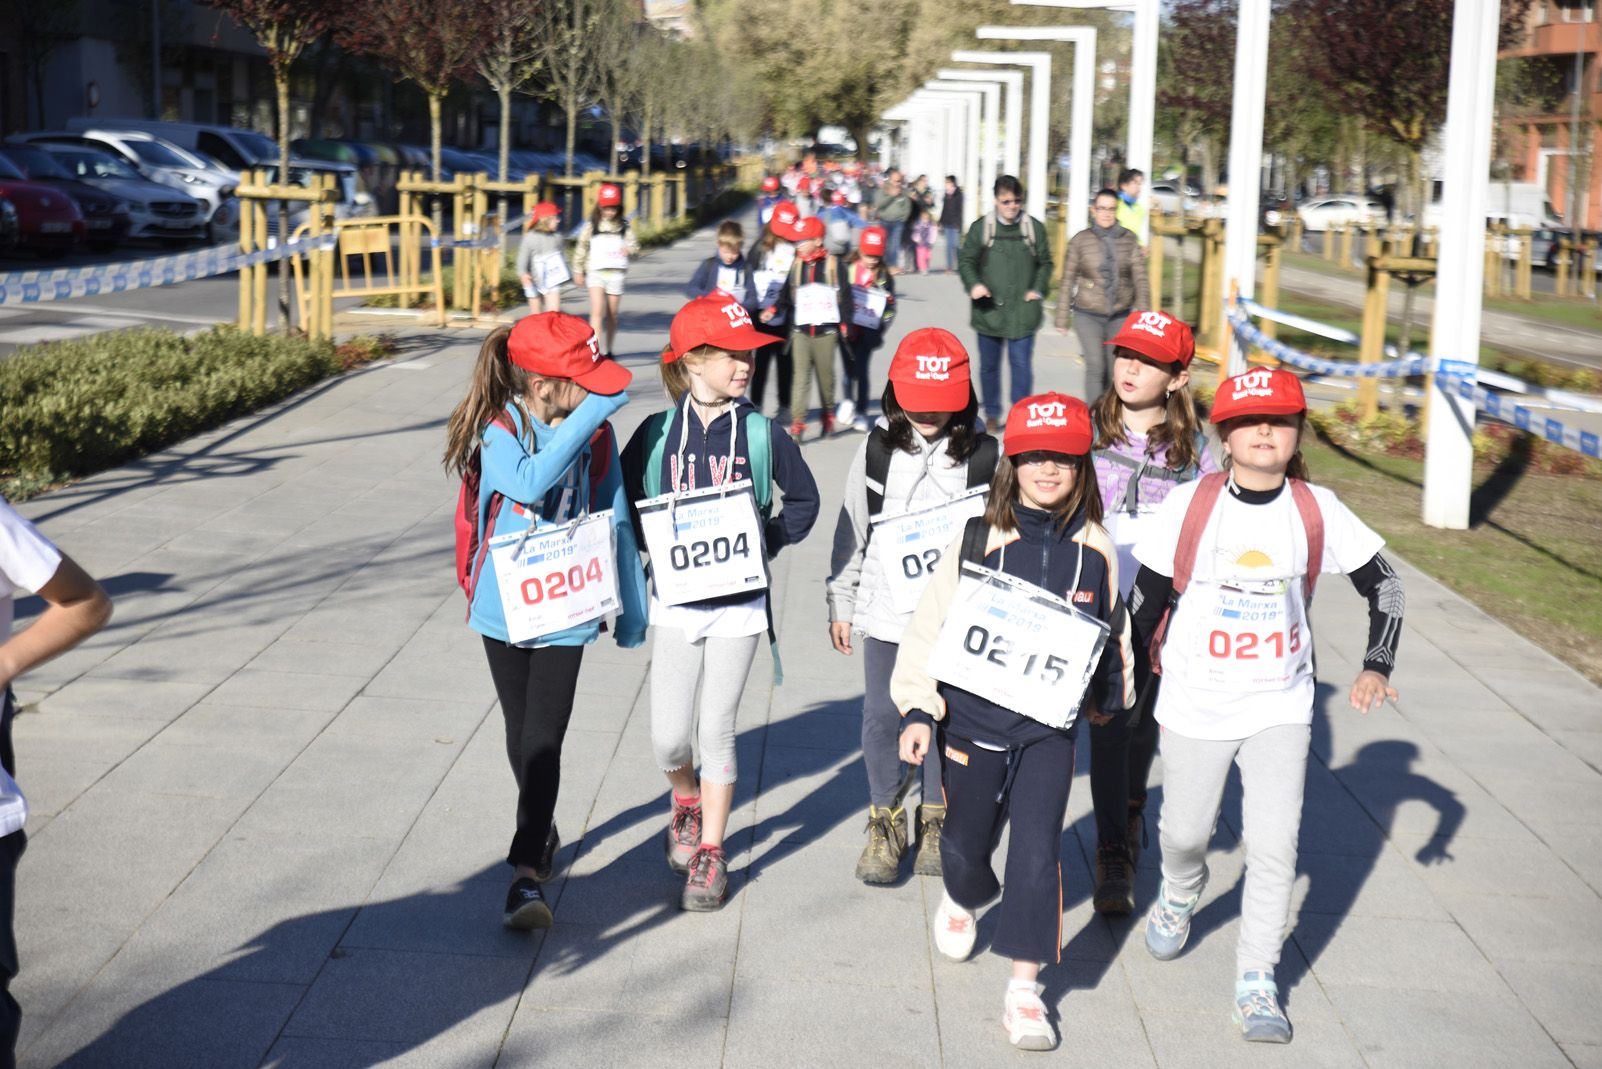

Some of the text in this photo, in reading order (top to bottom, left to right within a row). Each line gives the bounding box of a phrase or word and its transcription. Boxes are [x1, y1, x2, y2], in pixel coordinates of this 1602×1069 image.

[721, 302, 749, 320] TO
[1138, 311, 1172, 330] TOT
[916, 355, 951, 372] TOT
[1233, 371, 1272, 391] TOT
[1027, 401, 1067, 419] TOT
[539, 537, 572, 551] Marxa
[670, 531, 750, 571] 0204
[902, 544, 949, 580] 02
[521, 556, 603, 606] 0204
[1238, 598, 1278, 609] Marxa
[1209, 622, 1301, 660] 0215
[964, 624, 1069, 686] 0215
